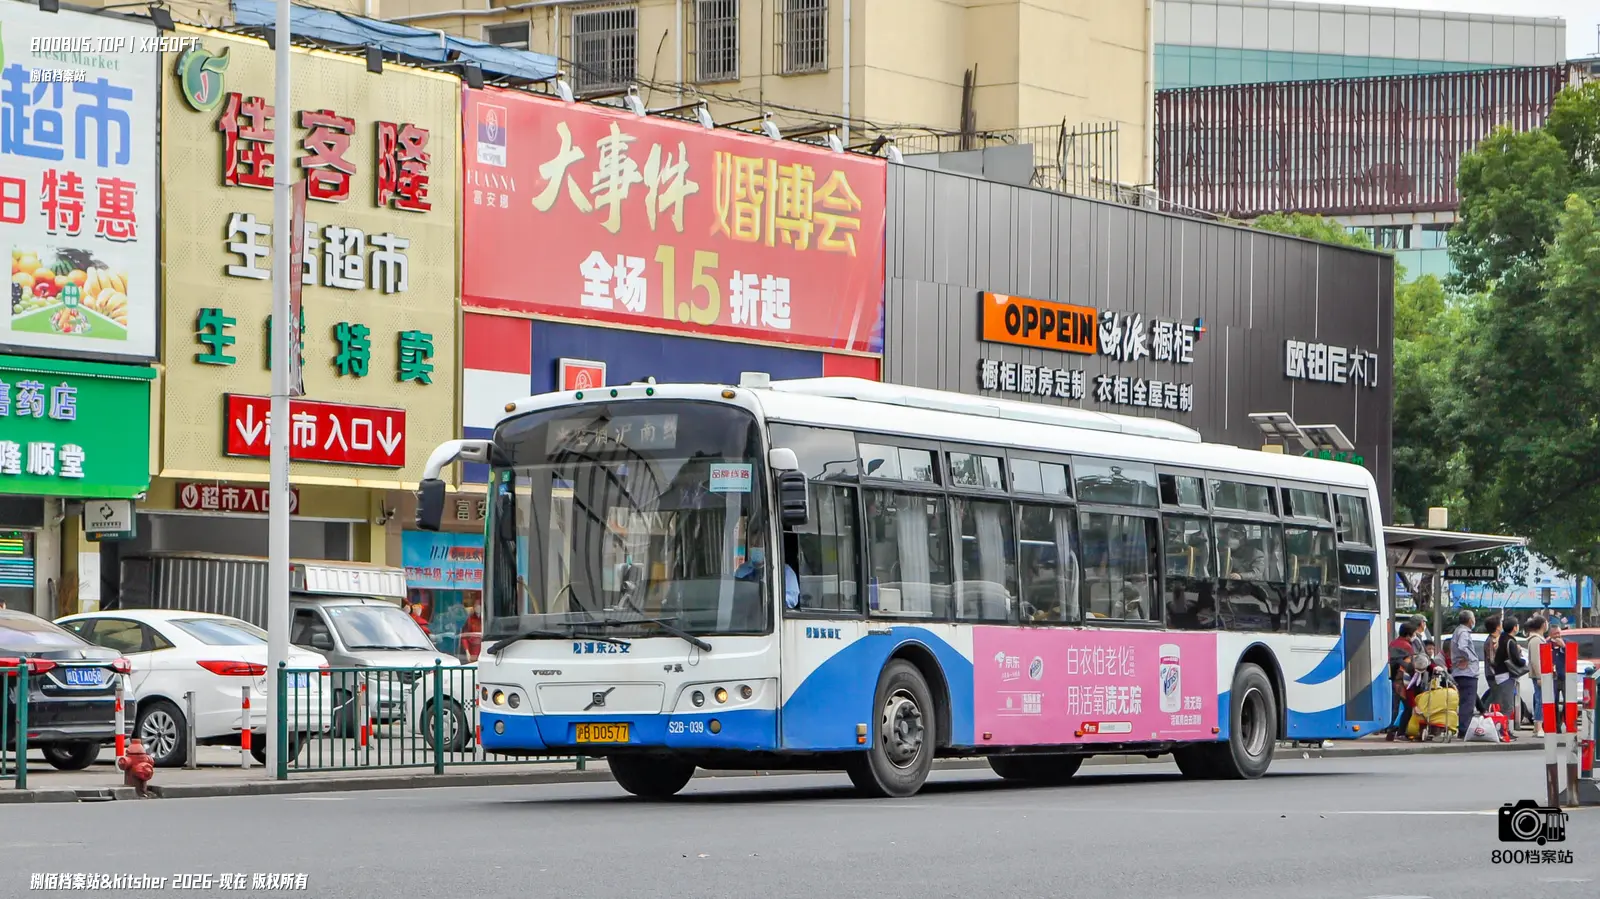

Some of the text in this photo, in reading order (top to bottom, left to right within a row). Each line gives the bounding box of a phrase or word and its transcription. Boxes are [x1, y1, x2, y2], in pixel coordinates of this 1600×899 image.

[0, 63, 133, 168] 超市
[218, 91, 432, 212] 佳客隆
[531, 120, 863, 257] 大事件 婚博会
[195, 308, 434, 384] 生特卖
[1004, 303, 1094, 347] OPPEIN
[265, 411, 373, 452] 市入口
[1344, 563, 1371, 576] VOLVO
[1067, 644, 1130, 676] 白衣怕老化
[1066, 685, 1142, 716] 用活氧渍无踪
[668, 721, 704, 734] S2B-039
